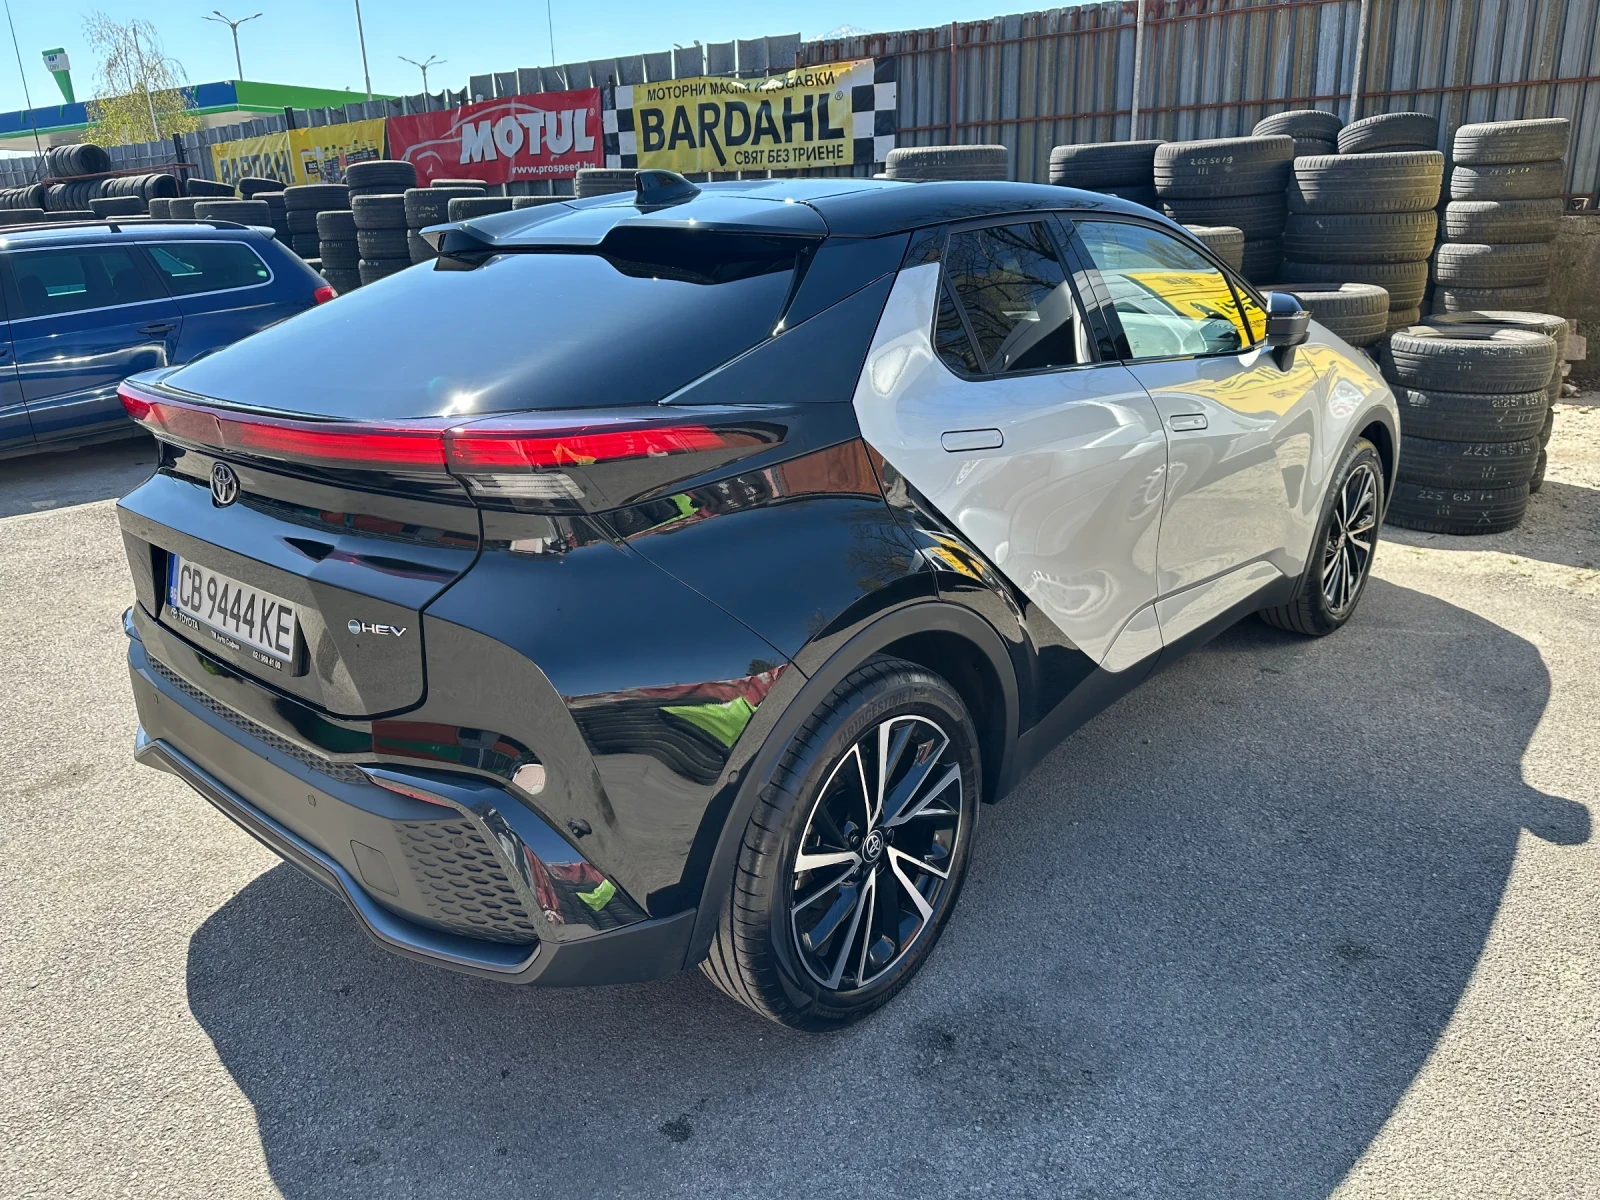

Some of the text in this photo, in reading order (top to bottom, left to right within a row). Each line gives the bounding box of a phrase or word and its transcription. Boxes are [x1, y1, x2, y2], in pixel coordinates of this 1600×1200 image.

[647, 84, 707, 102] МОТОРНИ
[459, 108, 595, 165] MOTUL
[640, 93, 846, 167] BARDAHL
[734, 144, 844, 165] СВЯТ БЕЗ ТРИЕНЕ
[1462, 445, 1493, 457] 225
[1418, 489, 1445, 501] 225
[1452, 493, 1471, 502] 65
[179, 563, 293, 656] CB 9444 KE
[178, 612, 200, 631] TOYOTA
[362, 622, 407, 637] HEV
[837, 691, 908, 748] BRIDGESTONE
